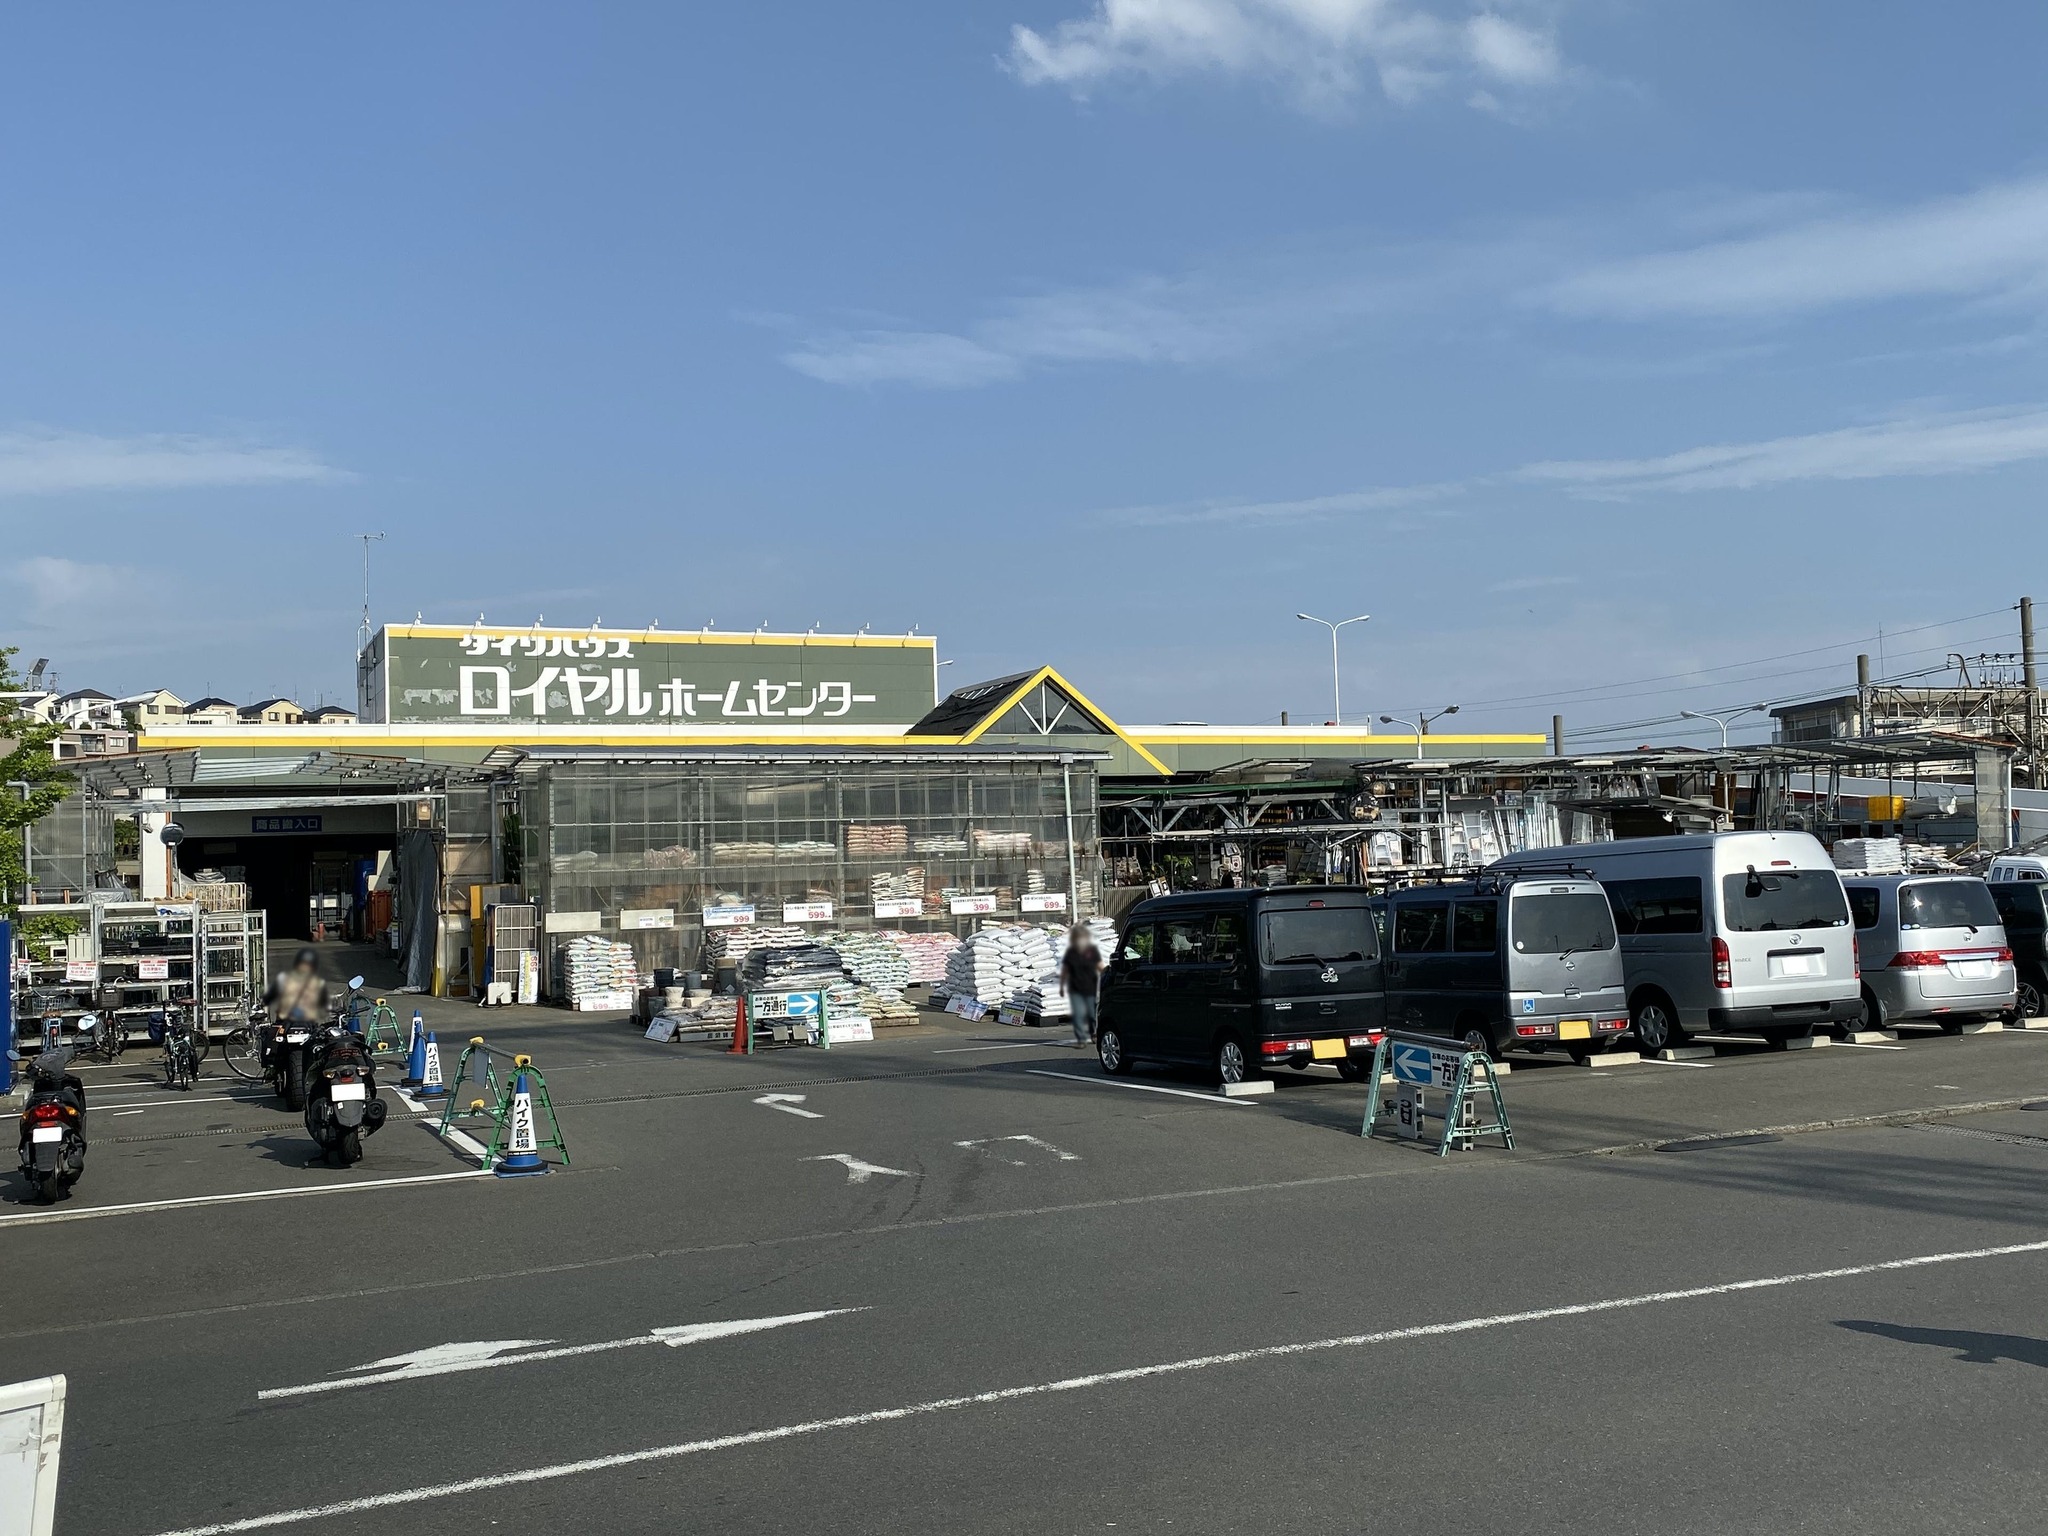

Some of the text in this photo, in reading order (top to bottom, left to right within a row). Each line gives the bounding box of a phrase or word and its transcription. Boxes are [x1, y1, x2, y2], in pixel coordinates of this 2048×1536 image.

[459, 634, 634, 658] ダイワハウス
[460, 666, 876, 716] ロイヤルホームセンター
[808, 911, 826, 919] 599
[754, 999, 788, 1013] 一方通行
[427, 1046, 439, 1082] バイク置場
[515, 1098, 530, 1149] バイク置場
